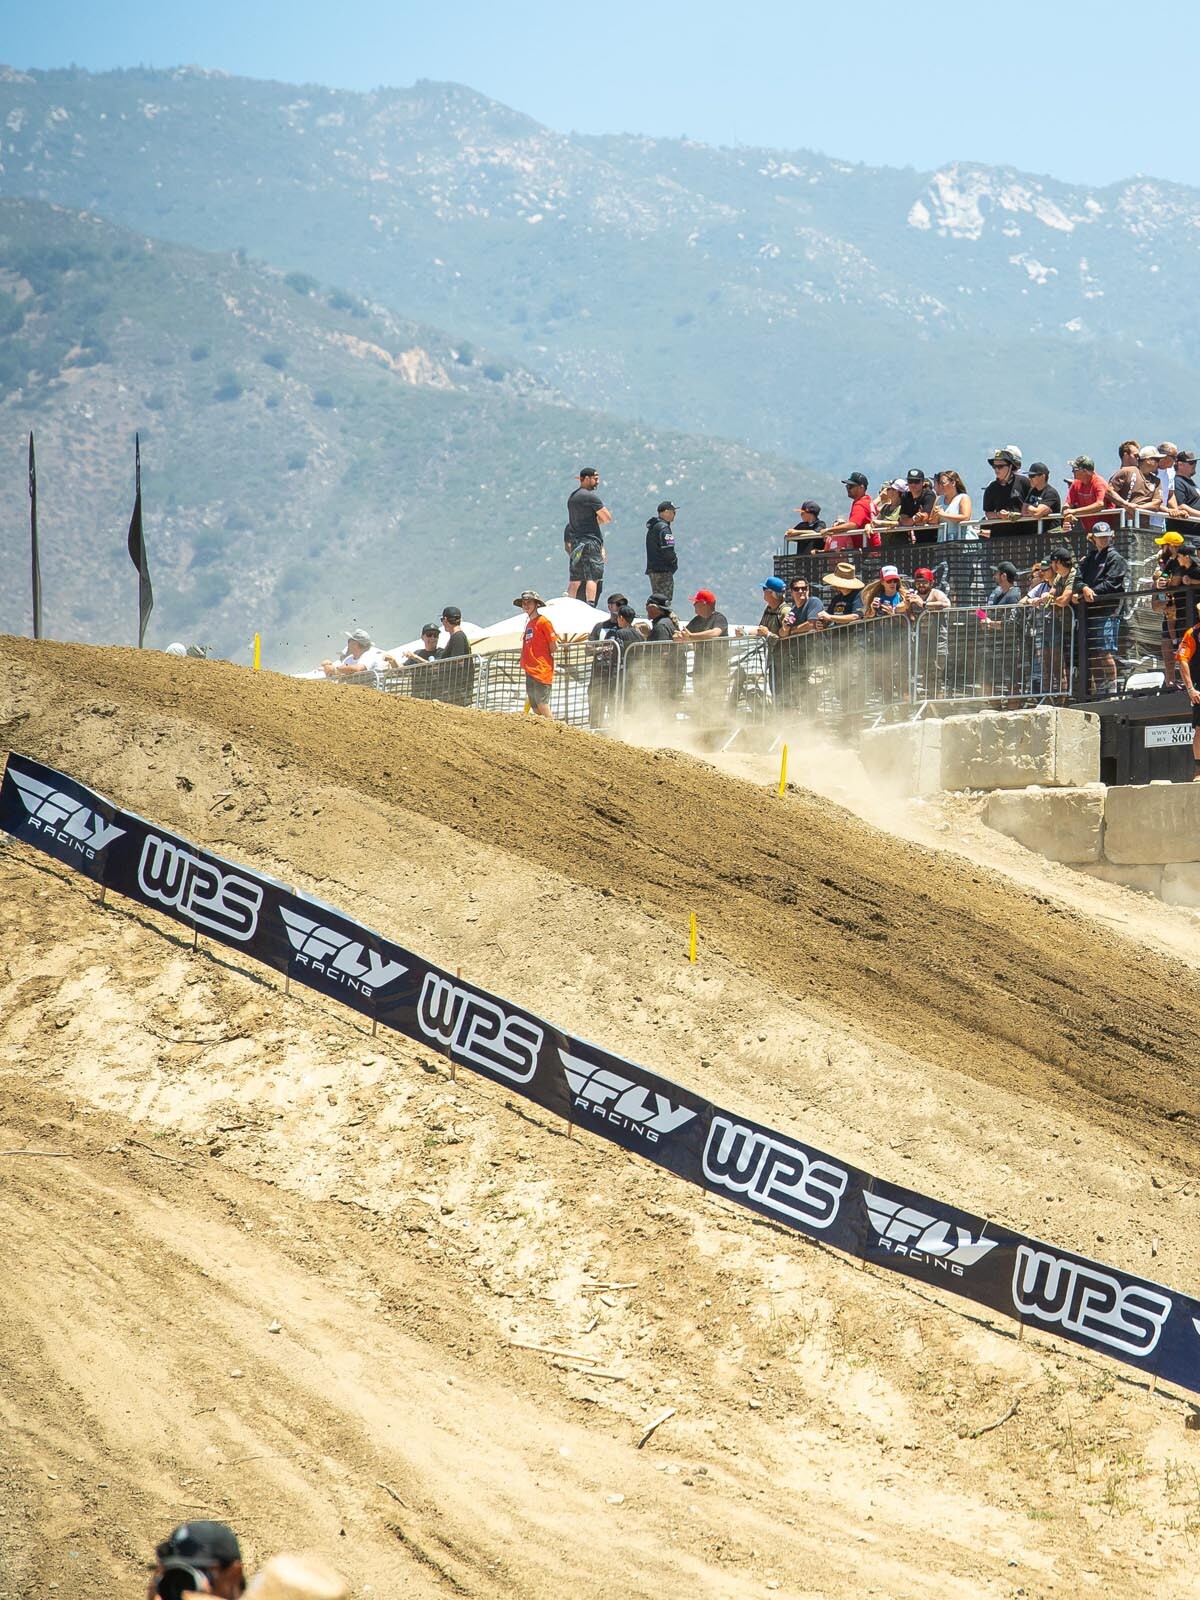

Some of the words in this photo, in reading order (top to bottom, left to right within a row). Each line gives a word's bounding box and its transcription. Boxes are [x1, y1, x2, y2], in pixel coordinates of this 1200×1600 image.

[18, 788, 127, 851] FLY
[27, 816, 95, 860] RACING
[138, 835, 264, 941] WPS
[286, 926, 409, 988] FLY
[295, 953, 373, 998] RACING
[417, 972, 544, 1084] WPS
[564, 1069, 698, 1134] FLY
[574, 1096, 660, 1143] RACING
[703, 1116, 849, 1229] WPS
[867, 1208, 999, 1266] FLY
[878, 1237, 964, 1277] RACING
[1013, 1245, 1173, 1357] WPS
